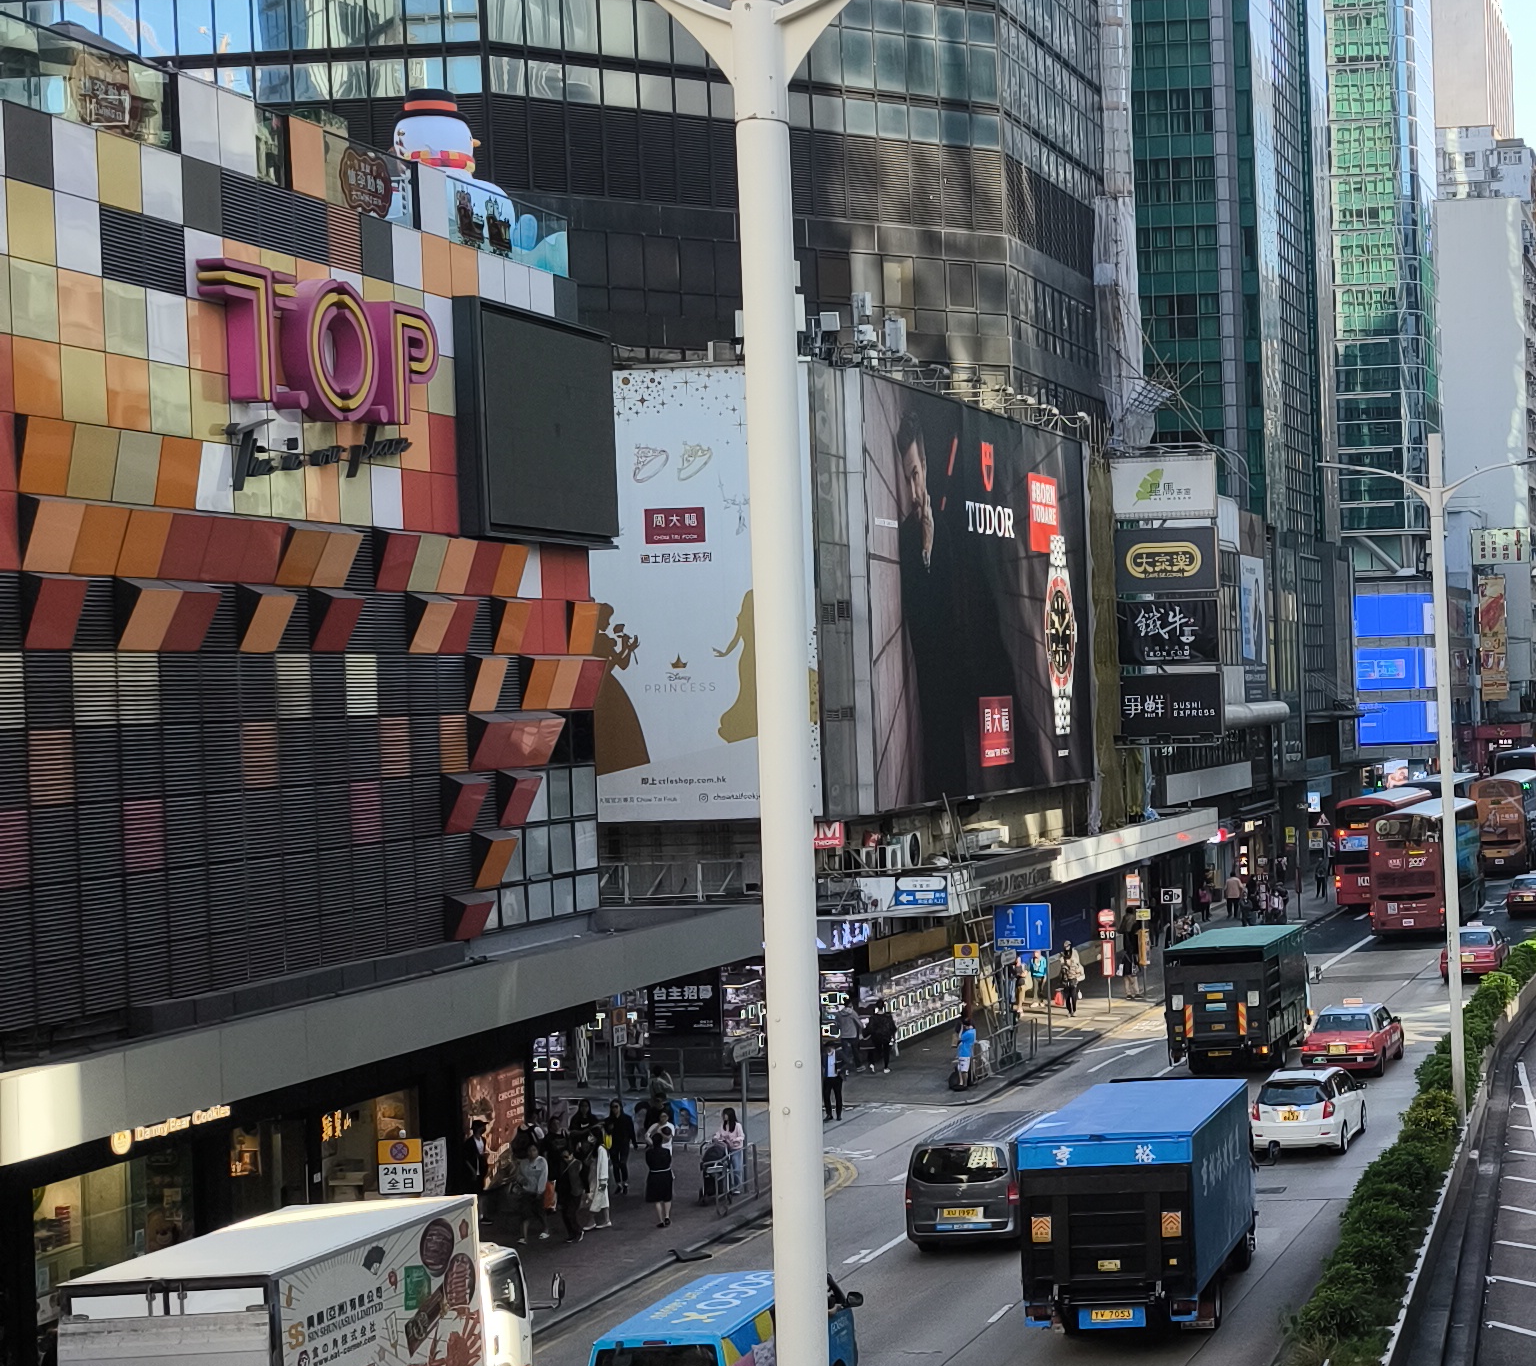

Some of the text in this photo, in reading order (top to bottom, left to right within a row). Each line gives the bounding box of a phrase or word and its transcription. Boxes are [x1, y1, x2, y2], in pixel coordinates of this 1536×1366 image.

[965, 500, 1015, 538] TUDOR
[644, 683, 716, 693] PRINCESS
[1173, 709, 1216, 717] EXPRESS
[653, 986, 713, 1000] 台主招募
[1135, 1144, 1156, 1163] 裕
[383, 1166, 418, 1176] 24 hrs
[387, 1178, 414, 1190] 全日
